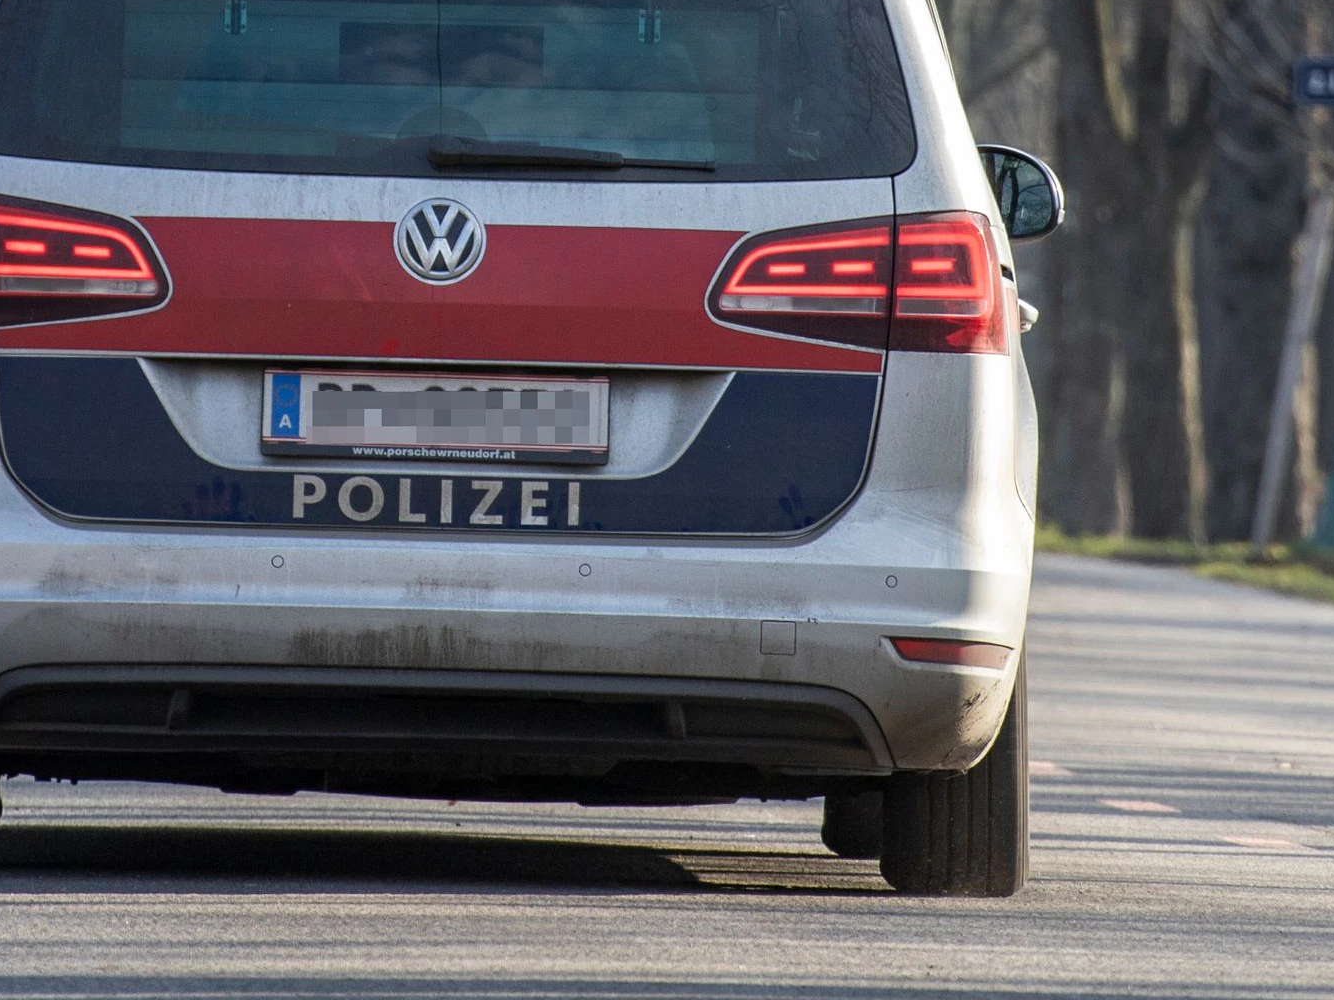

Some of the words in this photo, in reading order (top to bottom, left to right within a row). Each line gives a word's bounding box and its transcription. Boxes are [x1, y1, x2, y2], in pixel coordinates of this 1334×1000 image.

[399, 200, 479, 276] VW
[279, 414, 292, 428] A
[352, 446, 516, 460] www.porschewrneudorf.at
[292, 475, 581, 526] POLIZEI
